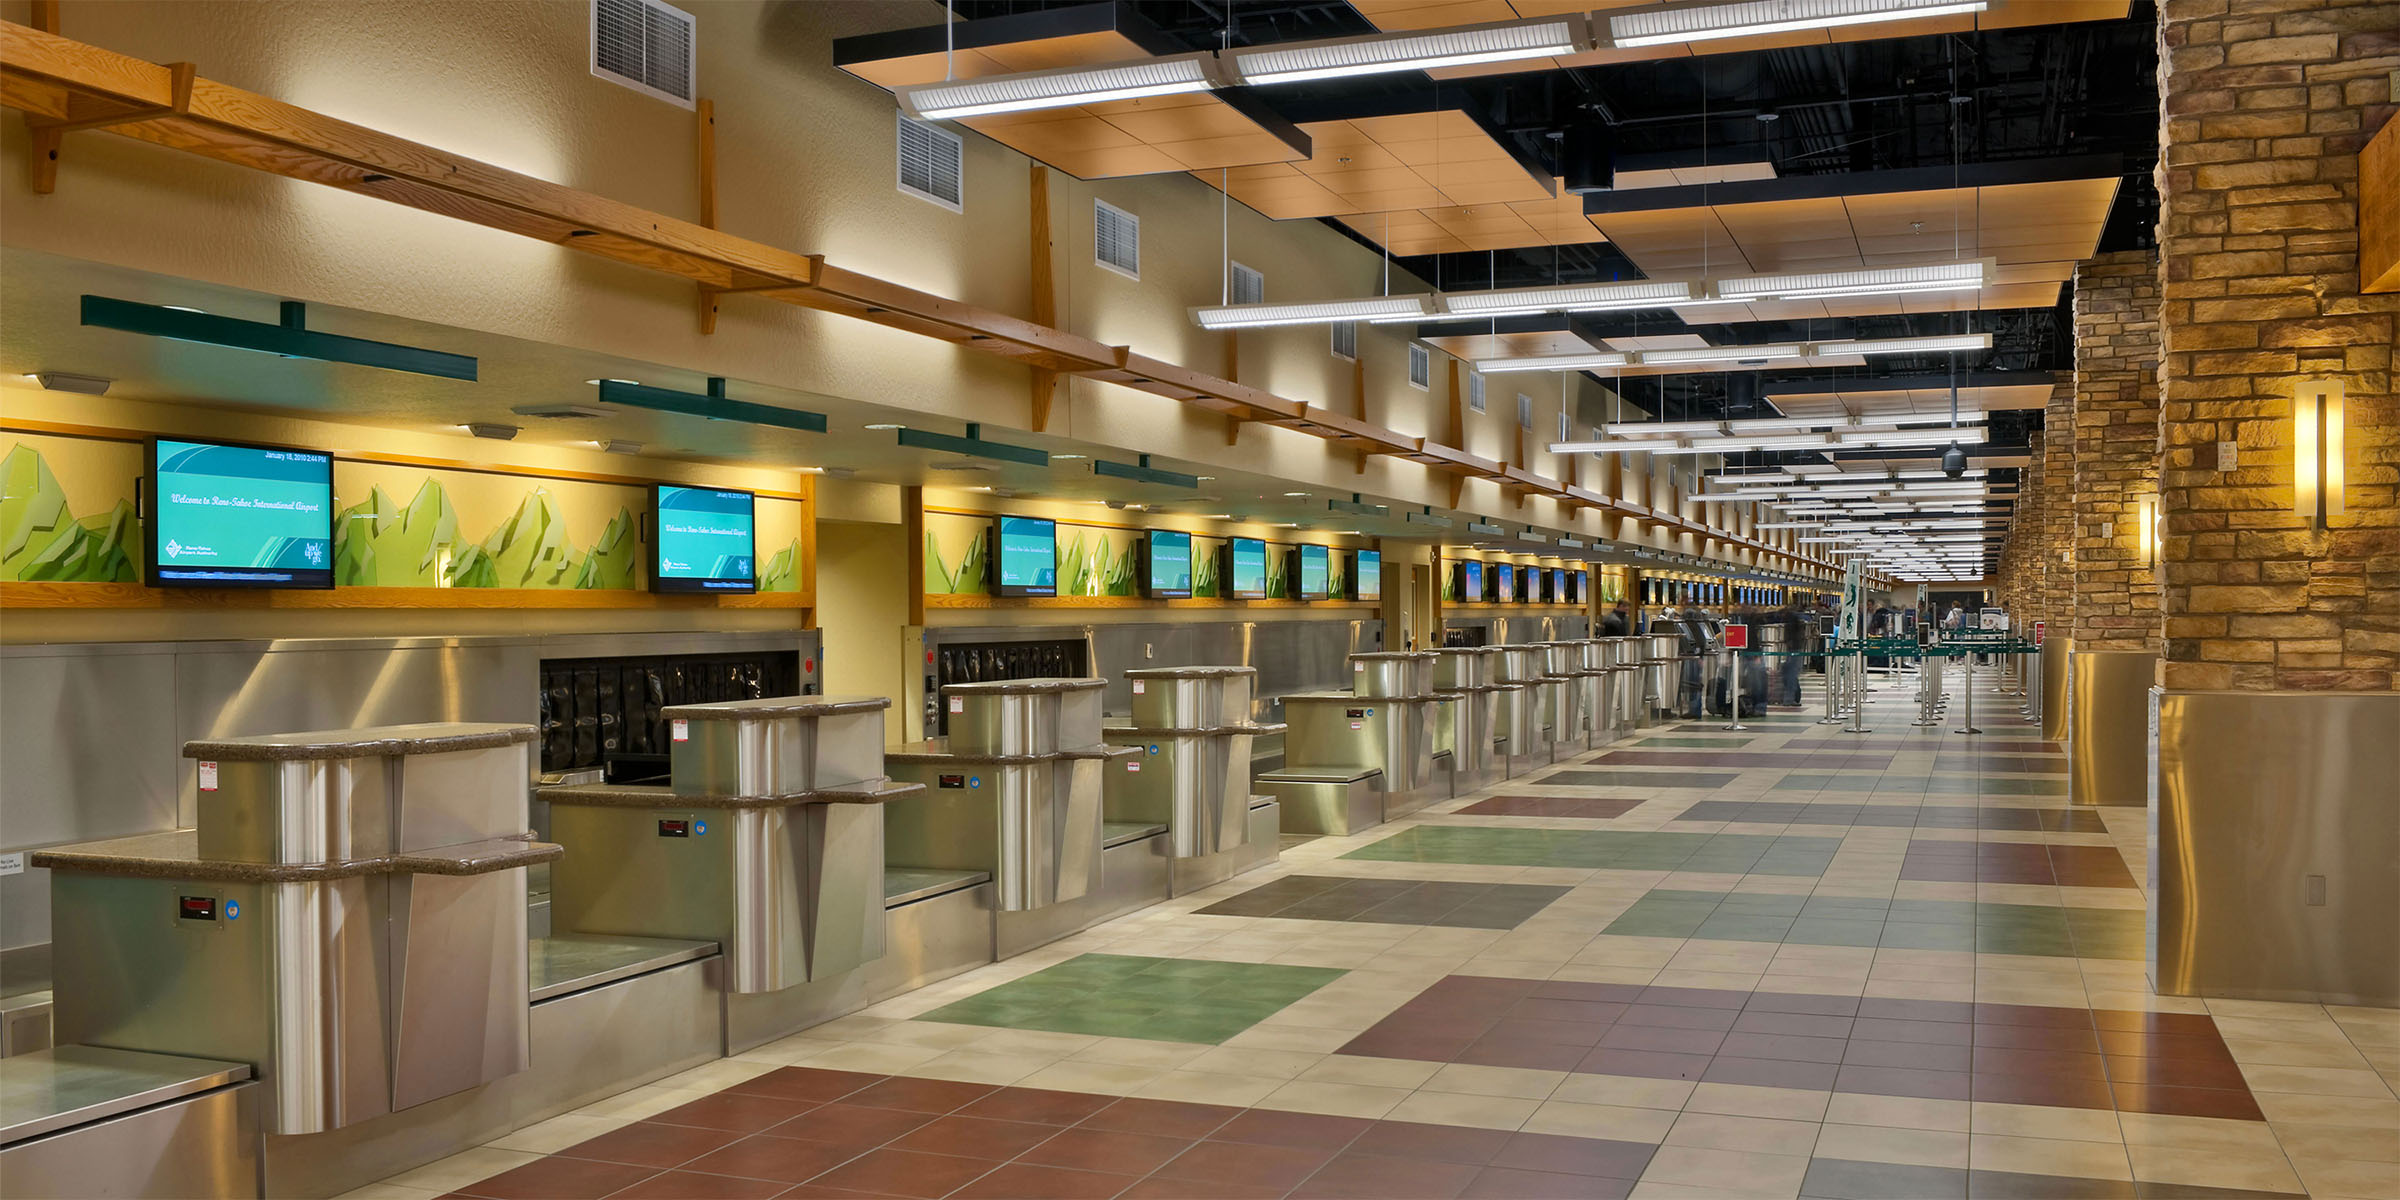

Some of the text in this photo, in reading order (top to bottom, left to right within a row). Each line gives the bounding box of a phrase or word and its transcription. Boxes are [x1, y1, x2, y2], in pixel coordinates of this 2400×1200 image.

[265, 451, 285, 461] January
[171, 493, 319, 513] Welcome to Reno-Tahoe International Airport
